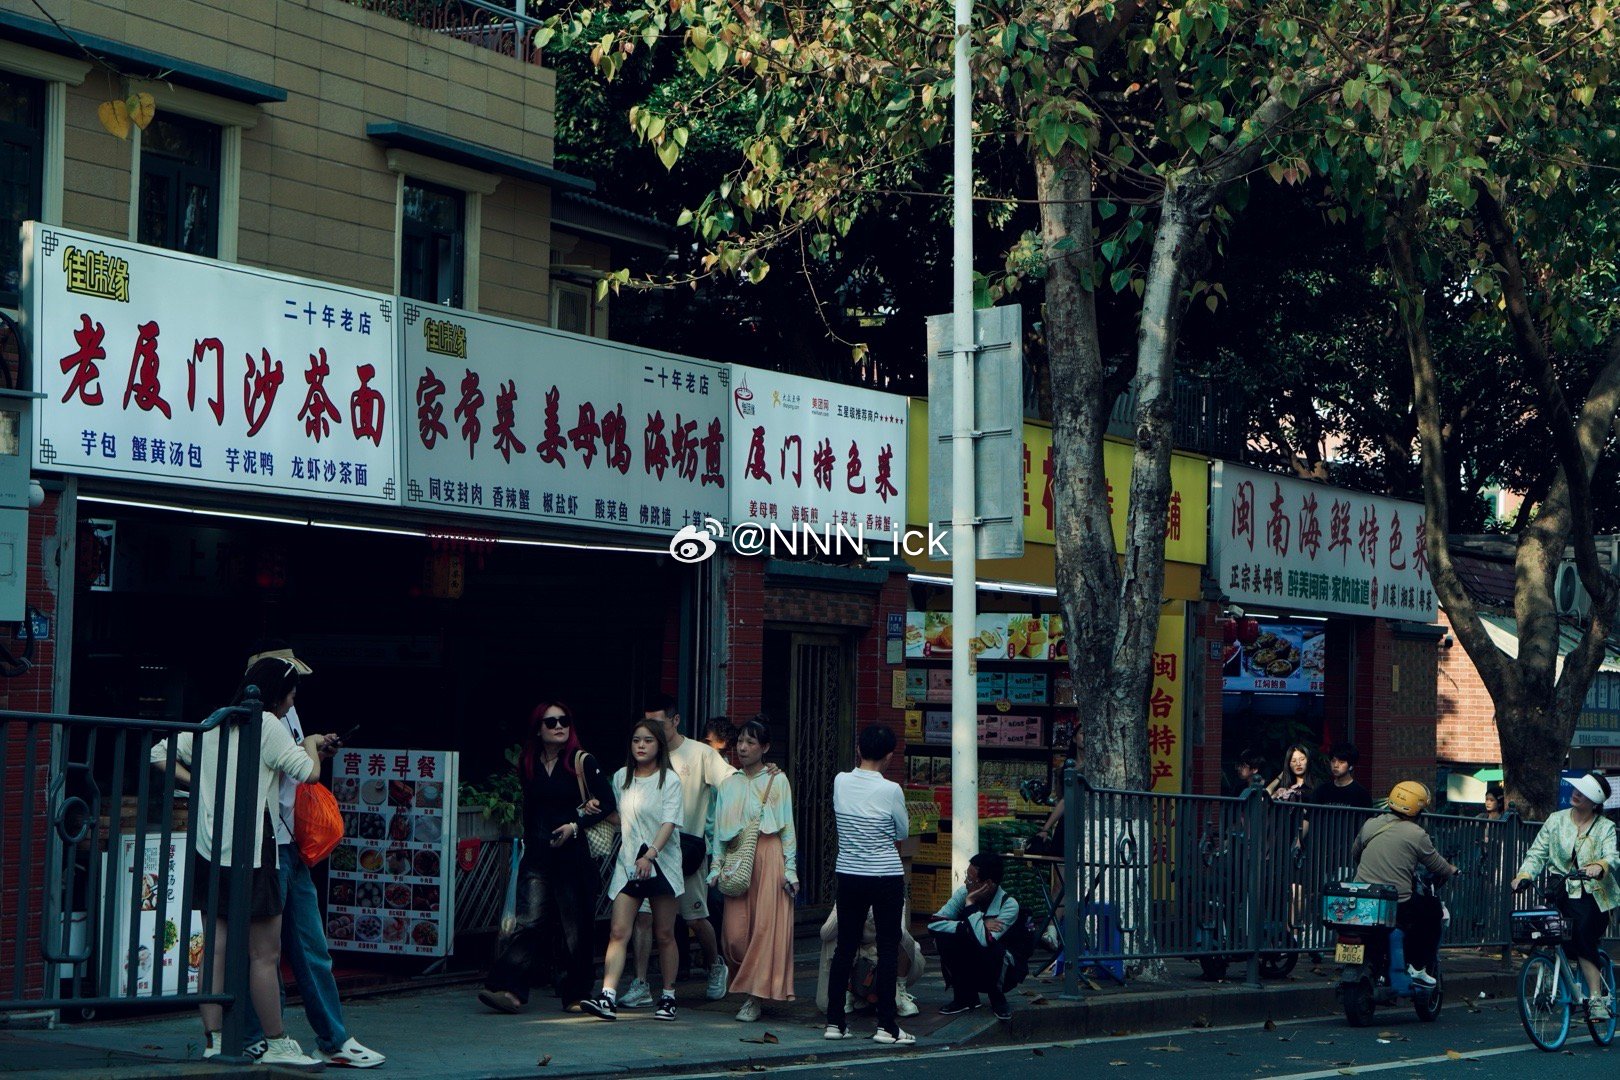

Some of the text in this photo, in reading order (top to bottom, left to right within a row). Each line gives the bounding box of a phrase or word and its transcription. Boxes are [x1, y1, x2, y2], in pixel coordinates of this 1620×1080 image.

[284, 299, 372, 336] 二十年老店
[60, 314, 386, 447] 老厦门沙茶面
[643, 366, 709, 396] 二十年老店
[81, 430, 368, 487] 芋包 蟹黄汤包 芋泥鸭 龙虾沙茶面
[744, 425, 898, 504] 厦门特色菜
[429, 477, 483, 506] 同安封肉
[492, 486, 530, 511] 香辣蟹
[542, 492, 578, 517] 椒盐虾
[594, 499, 628, 523] 酸菜鱼
[639, 504, 671, 527] 佛跳墙
[749, 500, 778, 521] 姜母鸭
[1231, 480, 1430, 581] 闽南海鲜特色菜
[1230, 563, 1283, 596] 正宗姜母鸭
[1148, 652, 1177, 791] 闽台特产
[343, 752, 436, 778] 营养早餐
